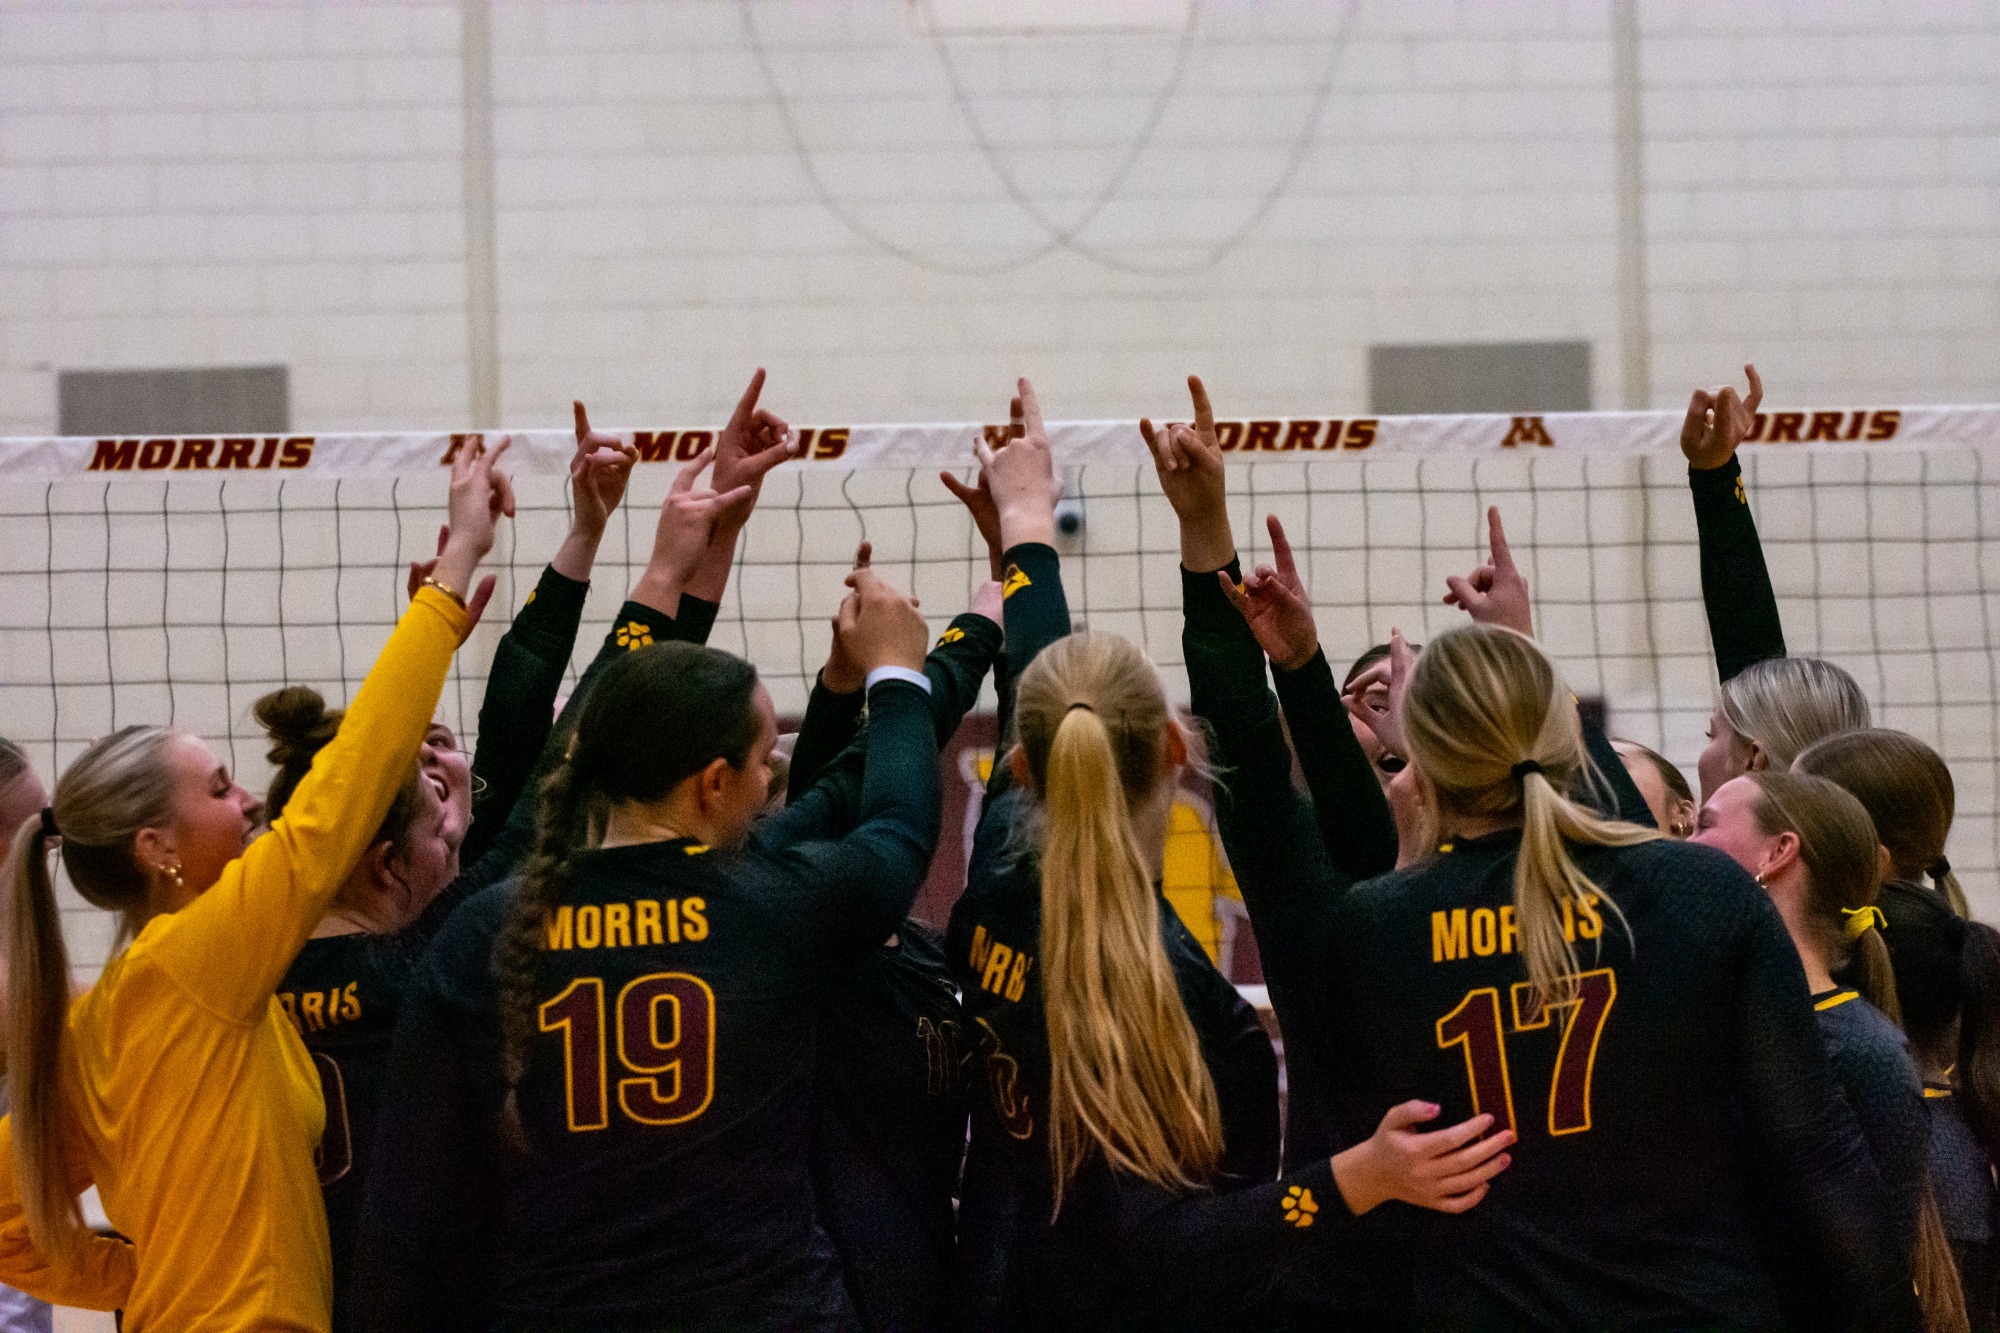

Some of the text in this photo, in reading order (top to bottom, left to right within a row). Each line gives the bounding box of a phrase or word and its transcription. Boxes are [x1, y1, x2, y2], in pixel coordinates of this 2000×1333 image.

[87, 437, 315, 471] MORRIS
[634, 428, 850, 462] MOIS
[1165, 419, 1379, 451] ORRIS
[1501, 416, 1554, 448] M
[541, 896, 709, 951] MORRIS
[1431, 893, 1604, 963] MORIS
[539, 972, 717, 1133] 19
[1436, 967, 1618, 1143] 17
